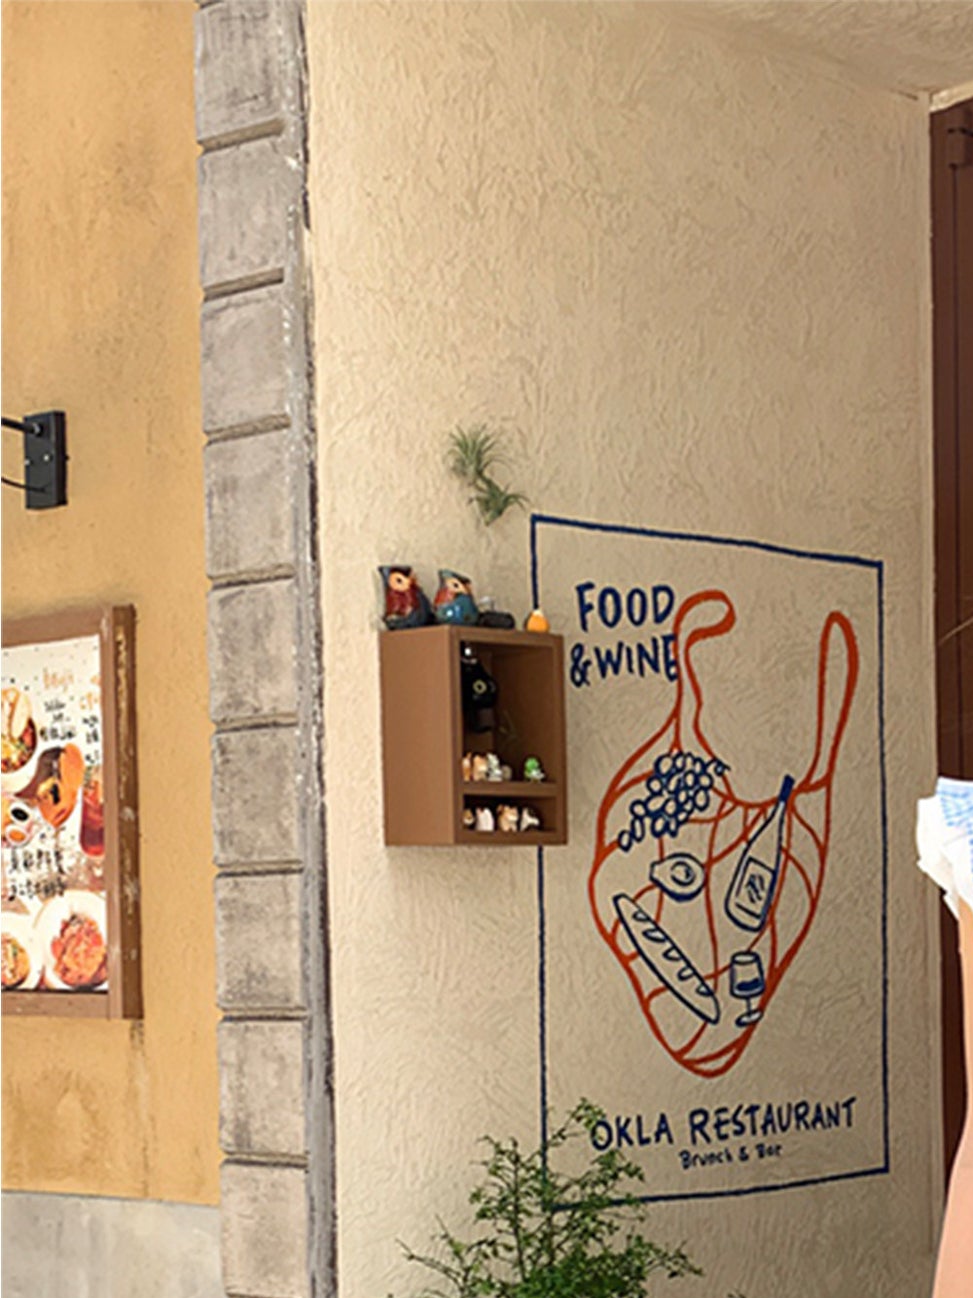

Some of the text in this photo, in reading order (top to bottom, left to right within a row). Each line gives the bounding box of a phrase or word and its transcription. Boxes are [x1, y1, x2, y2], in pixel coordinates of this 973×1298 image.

[575, 582, 675, 633] FOOD
[591, 1096, 858, 1151] OKLA RESTAURANT
[678, 1147, 733, 1170] Brunch
[738, 1145, 750, 1162] &
